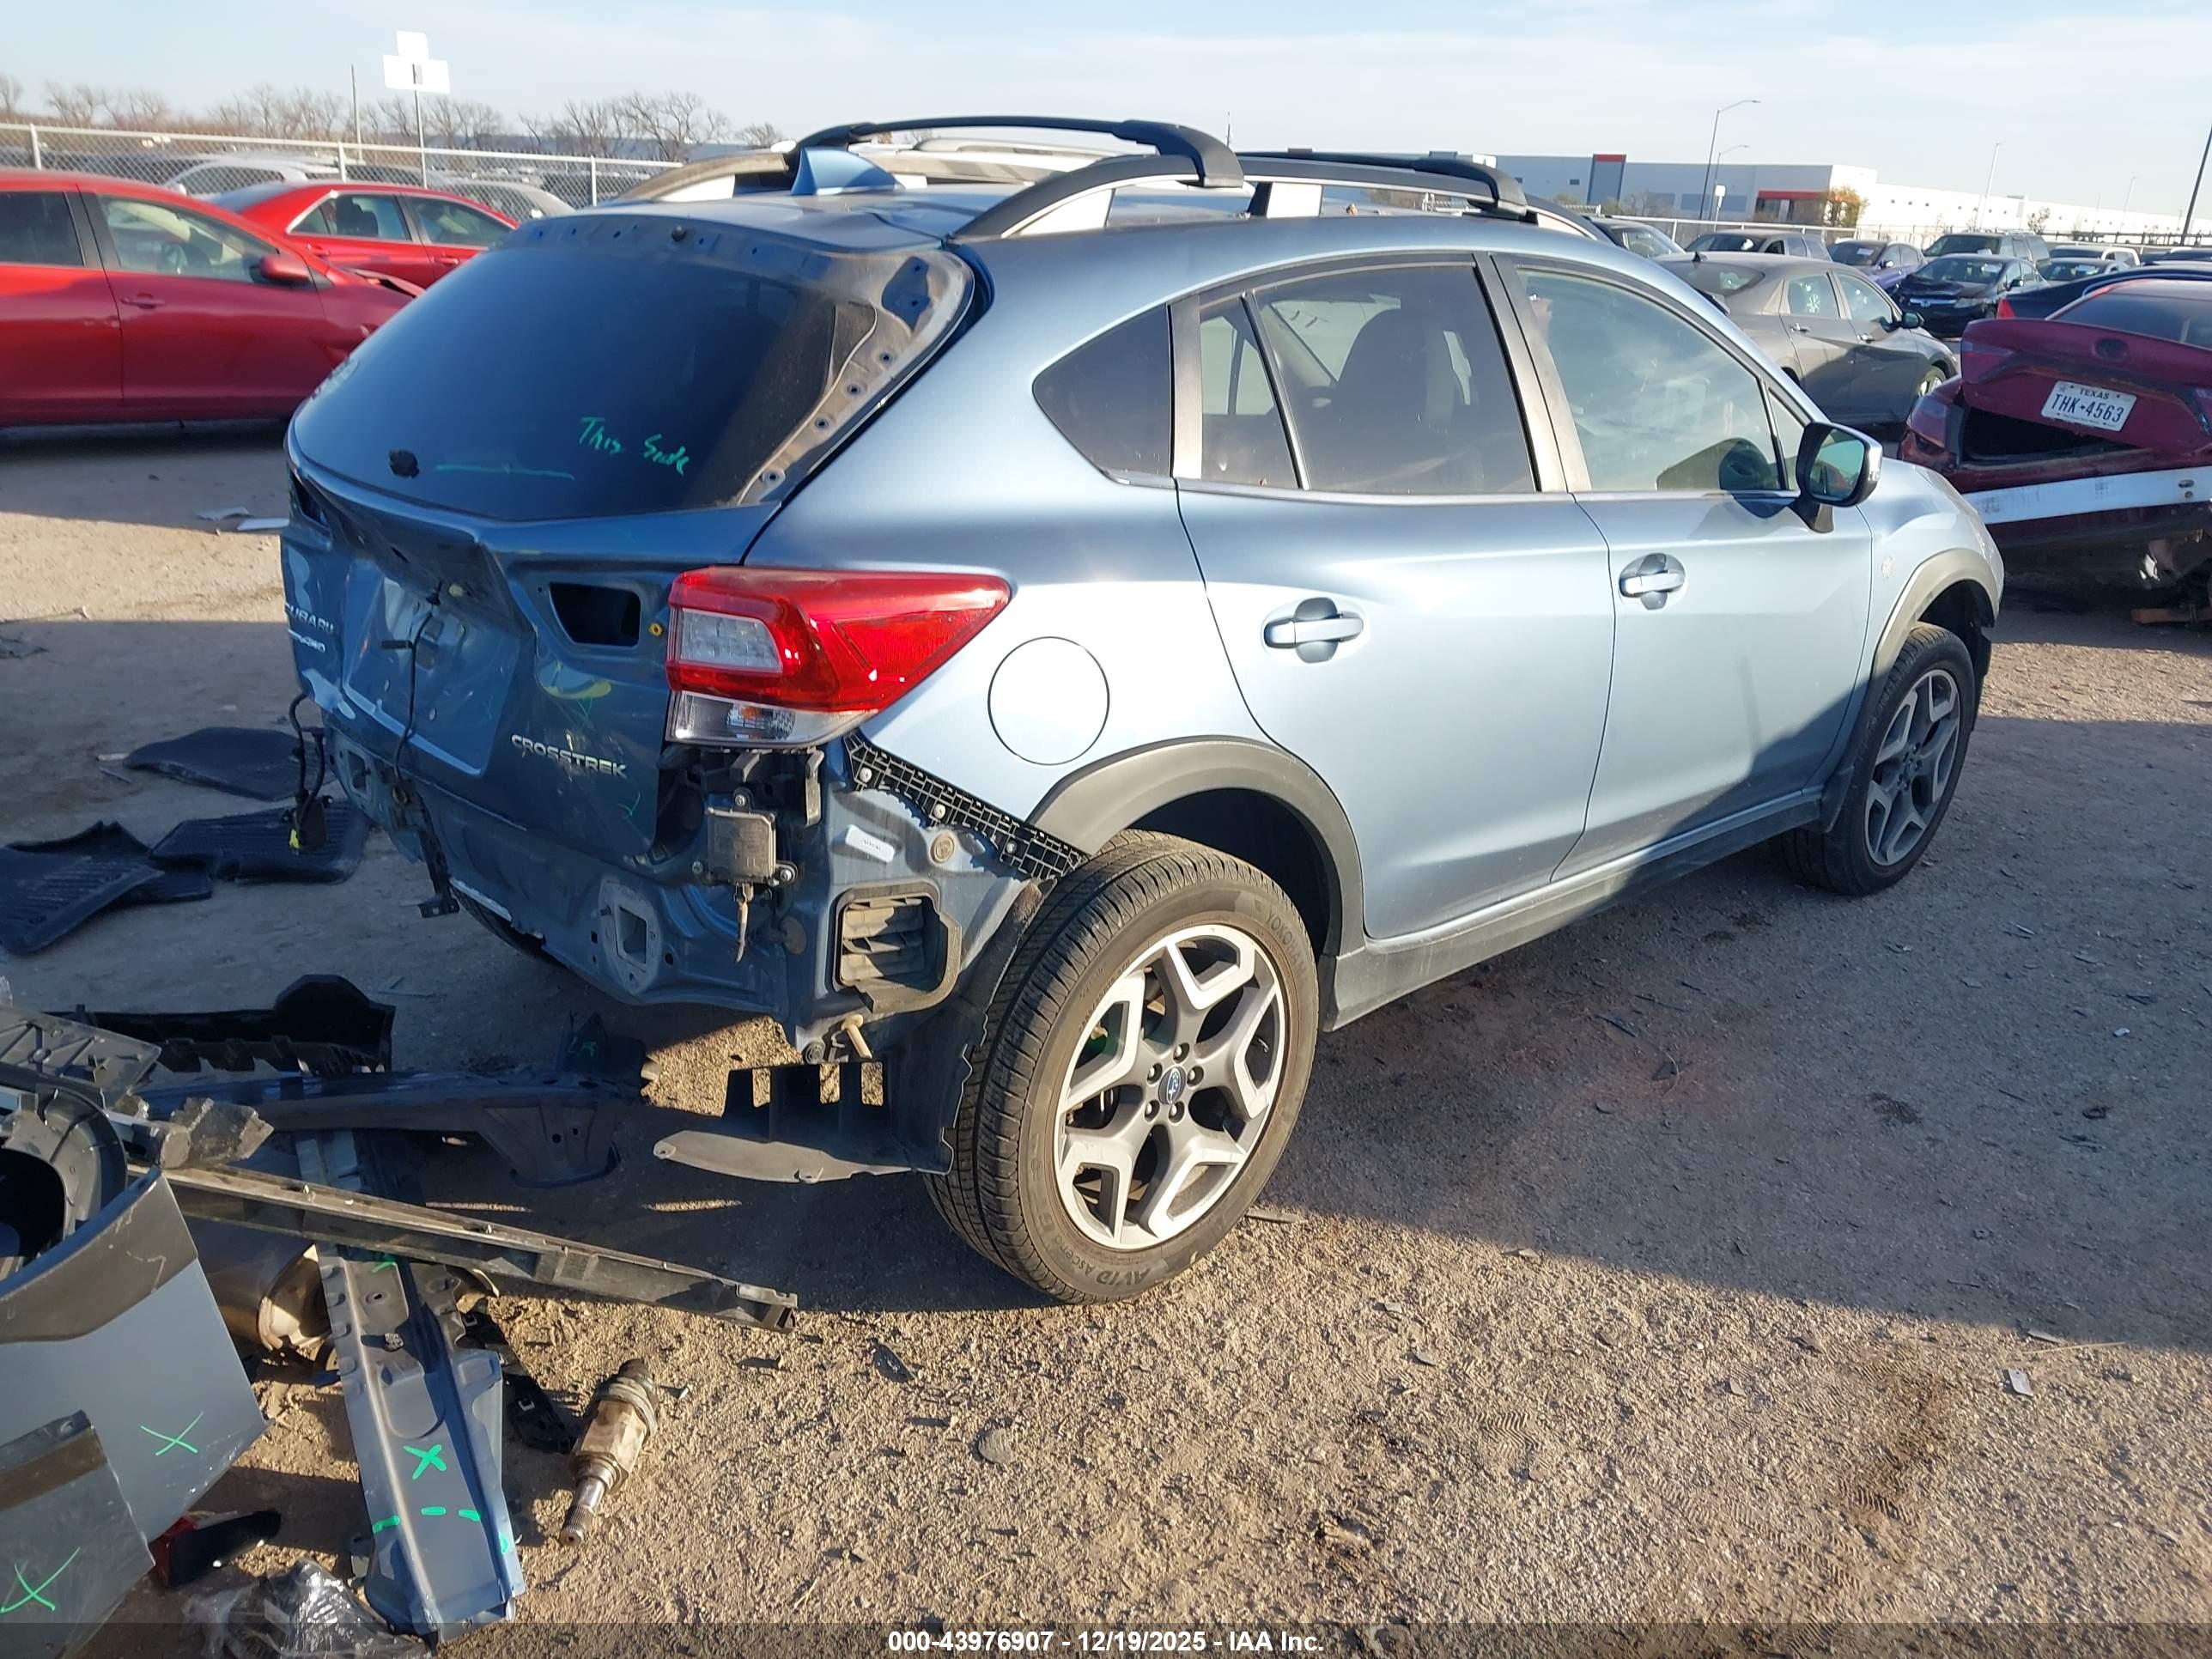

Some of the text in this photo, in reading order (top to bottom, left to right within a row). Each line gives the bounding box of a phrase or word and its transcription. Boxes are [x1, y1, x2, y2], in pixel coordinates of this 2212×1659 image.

[2051, 394, 2080, 412] THK
[2085, 401, 2124, 422] 4563
[2080, 389, 2109, 399] TEXAS
[579, 416, 622, 455] This
[511, 734, 627, 779] CROSSTREK
